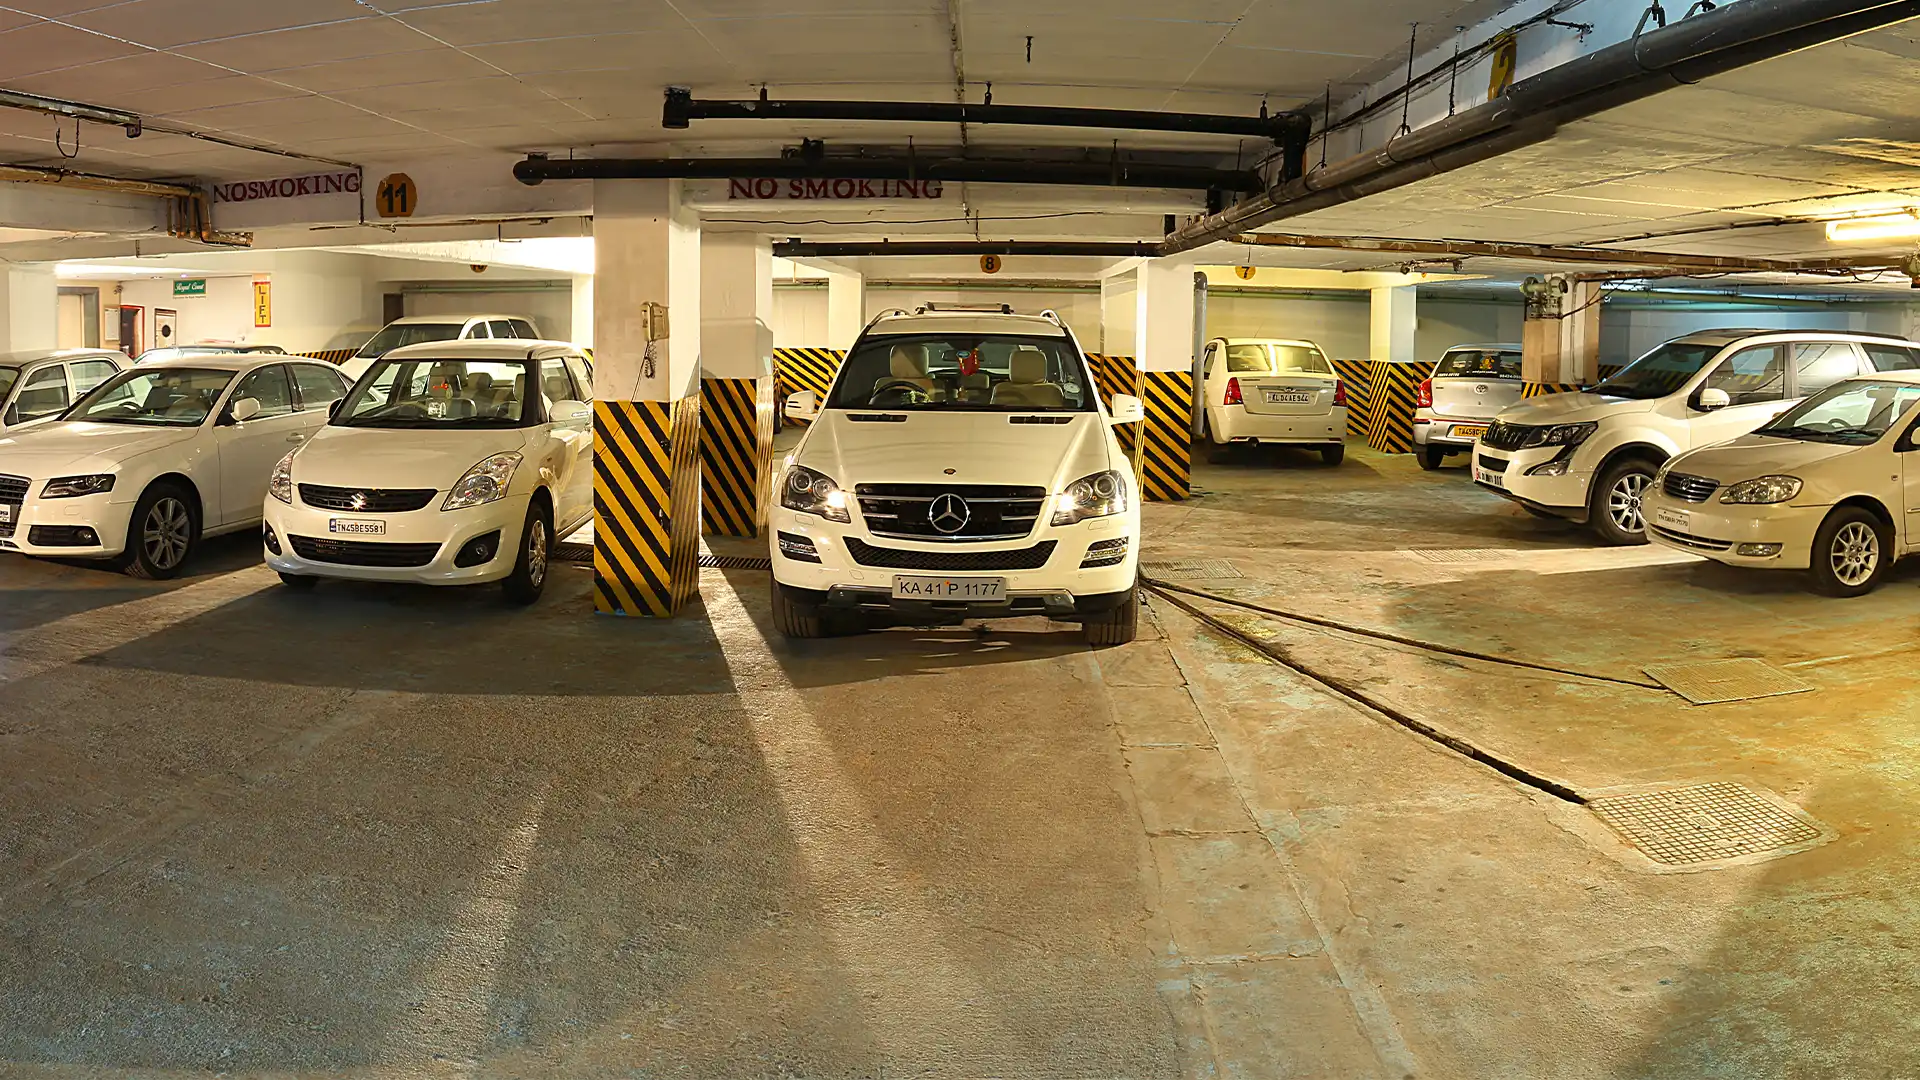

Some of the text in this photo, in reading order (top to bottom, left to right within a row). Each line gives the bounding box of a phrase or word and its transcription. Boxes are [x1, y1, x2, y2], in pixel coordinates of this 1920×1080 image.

[729, 178, 943, 199] NO SMOKING
[381, 183, 407, 213] 11
[985, 256, 995, 270] 8
[1241, 266, 1250, 278] 7
[258, 285, 266, 323] LIFT
[900, 581, 999, 595] KA 41 P 1177
